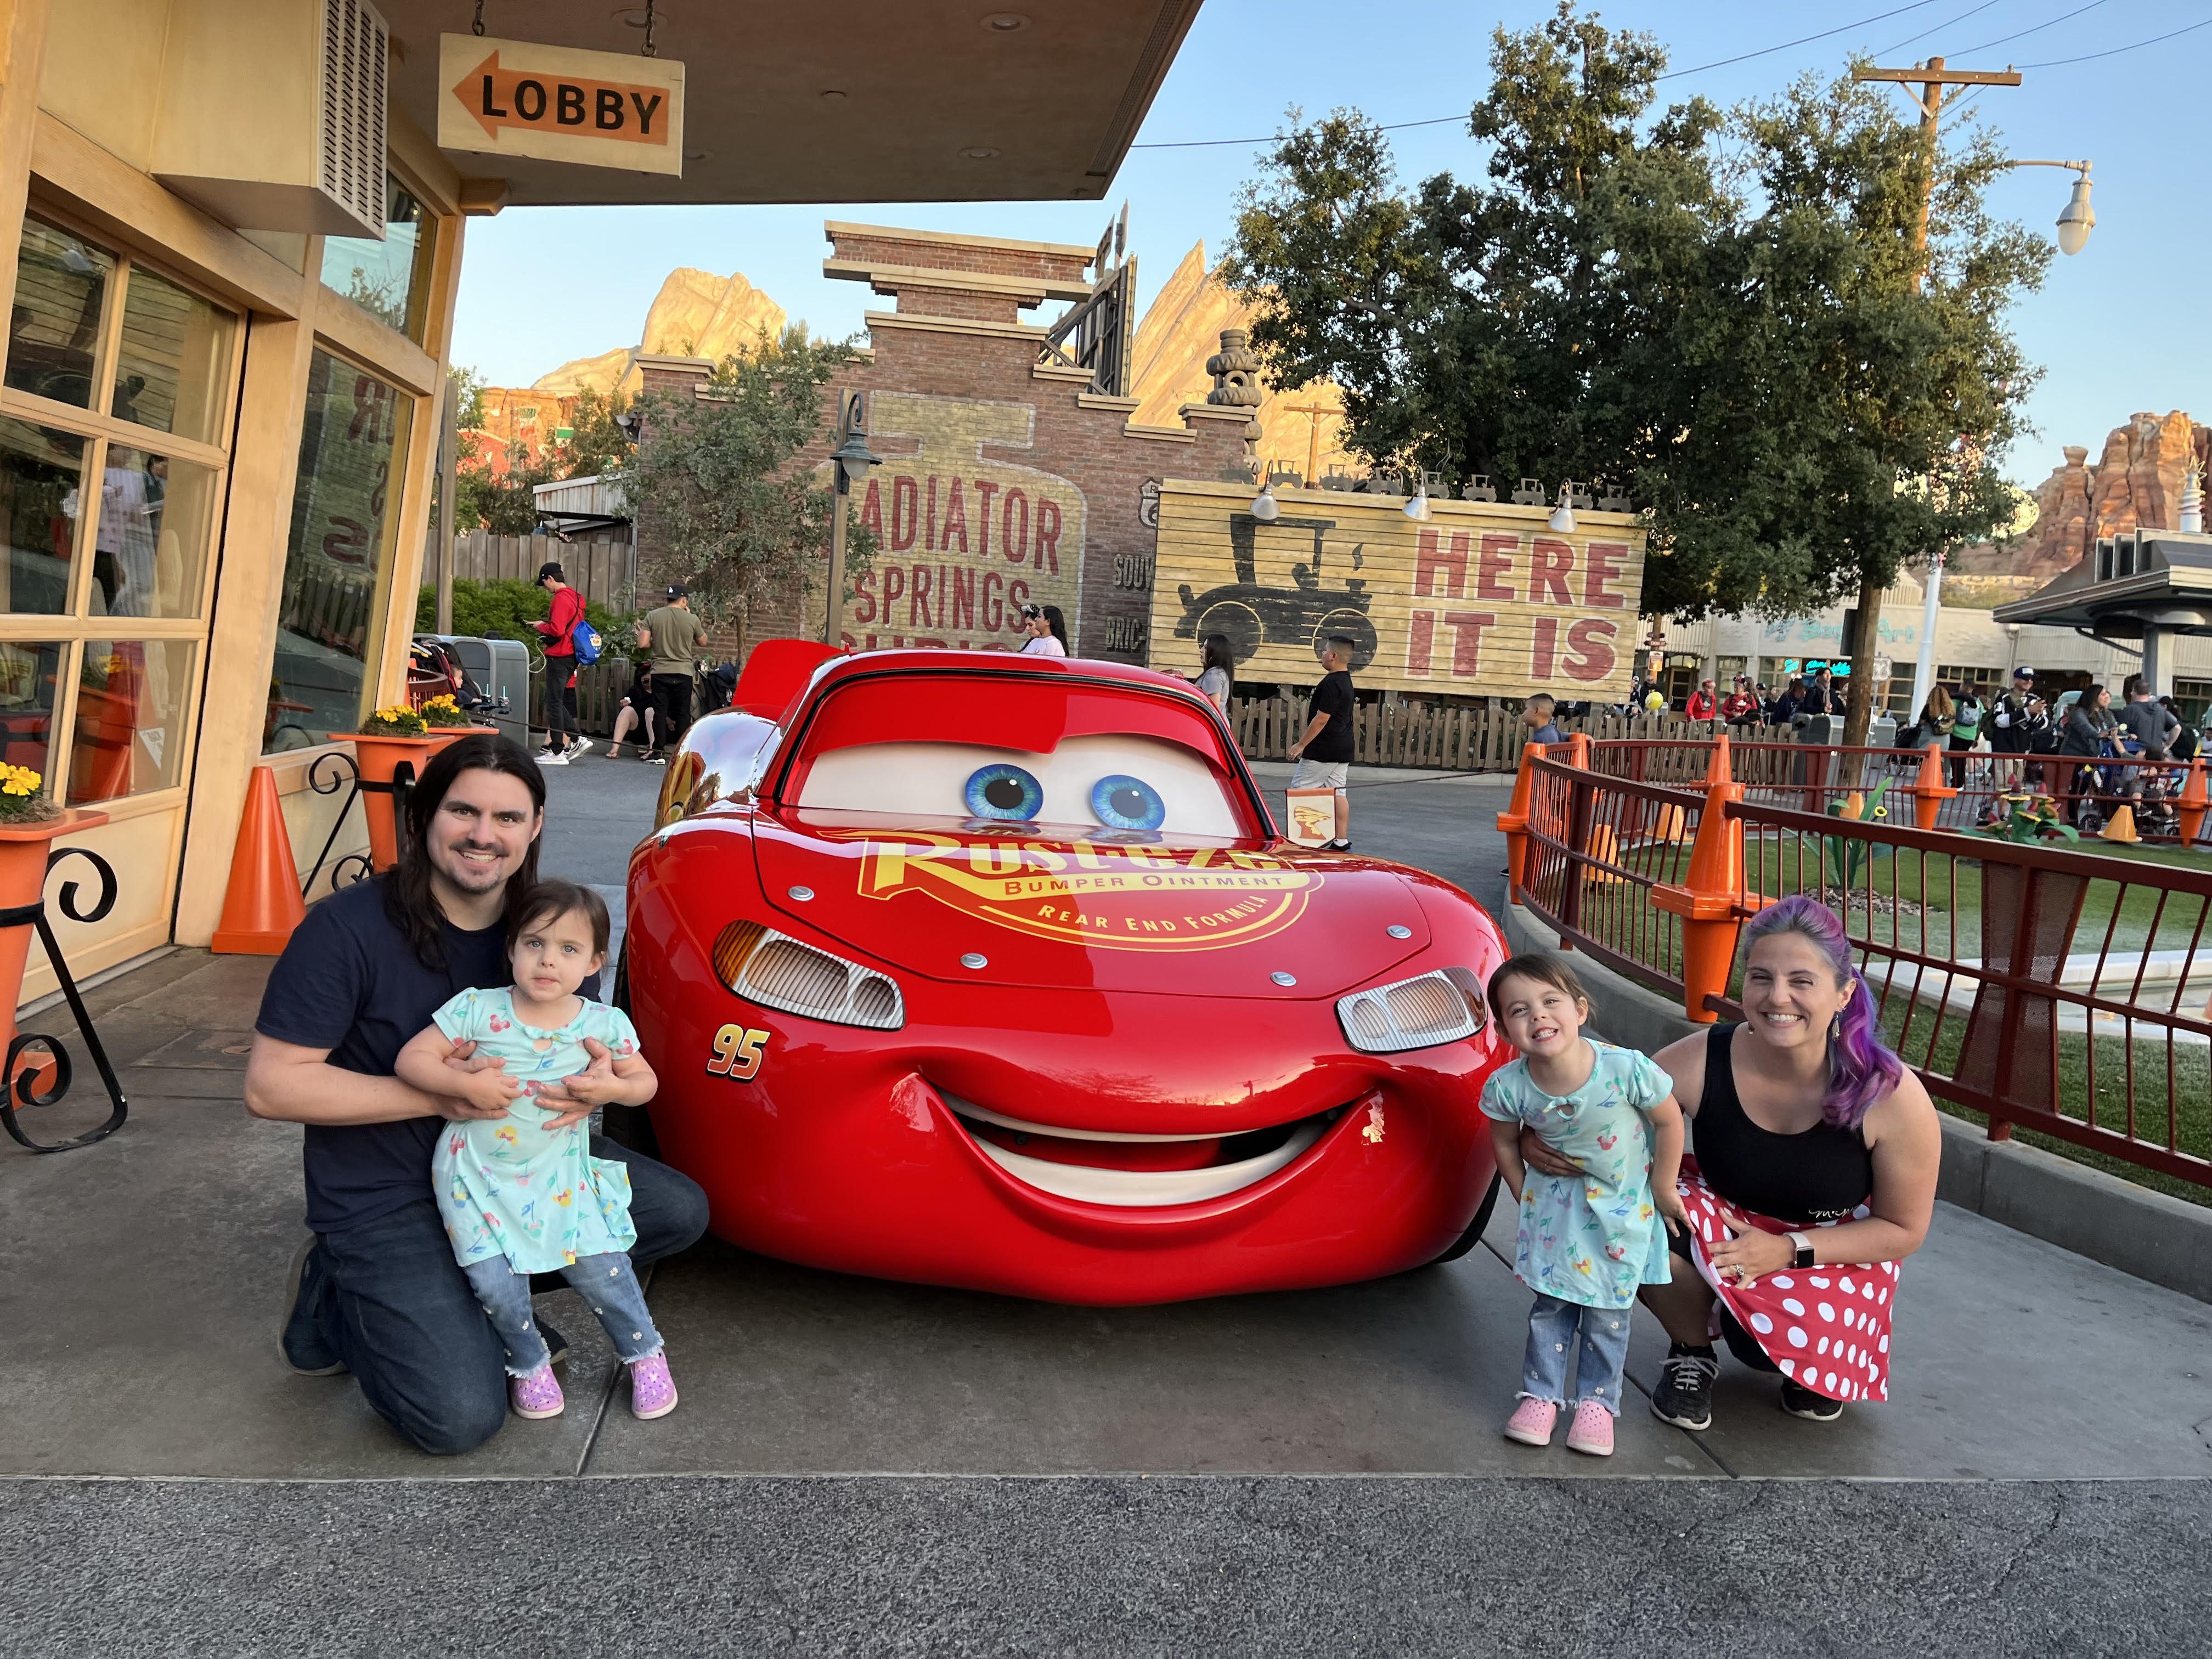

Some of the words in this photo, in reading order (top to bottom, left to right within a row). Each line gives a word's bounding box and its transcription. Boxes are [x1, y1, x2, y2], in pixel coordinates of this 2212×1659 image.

[482, 75, 662, 134] LOBBY
[856, 475, 1062, 576] ADIATOR
[854, 564, 1031, 634] SPRINGS
[1413, 528, 1630, 608] HERE
[1406, 610, 1496, 678] IT
[1530, 617, 1619, 682] IS
[1004, 877, 1125, 896] BUMPER
[1142, 874, 1283, 887] OINTMENT
[1037, 904, 1108, 929] REAR
[1125, 917, 1177, 932] END
[1183, 895, 1269, 929] FORMULA
[706, 1023, 771, 1082] 95
